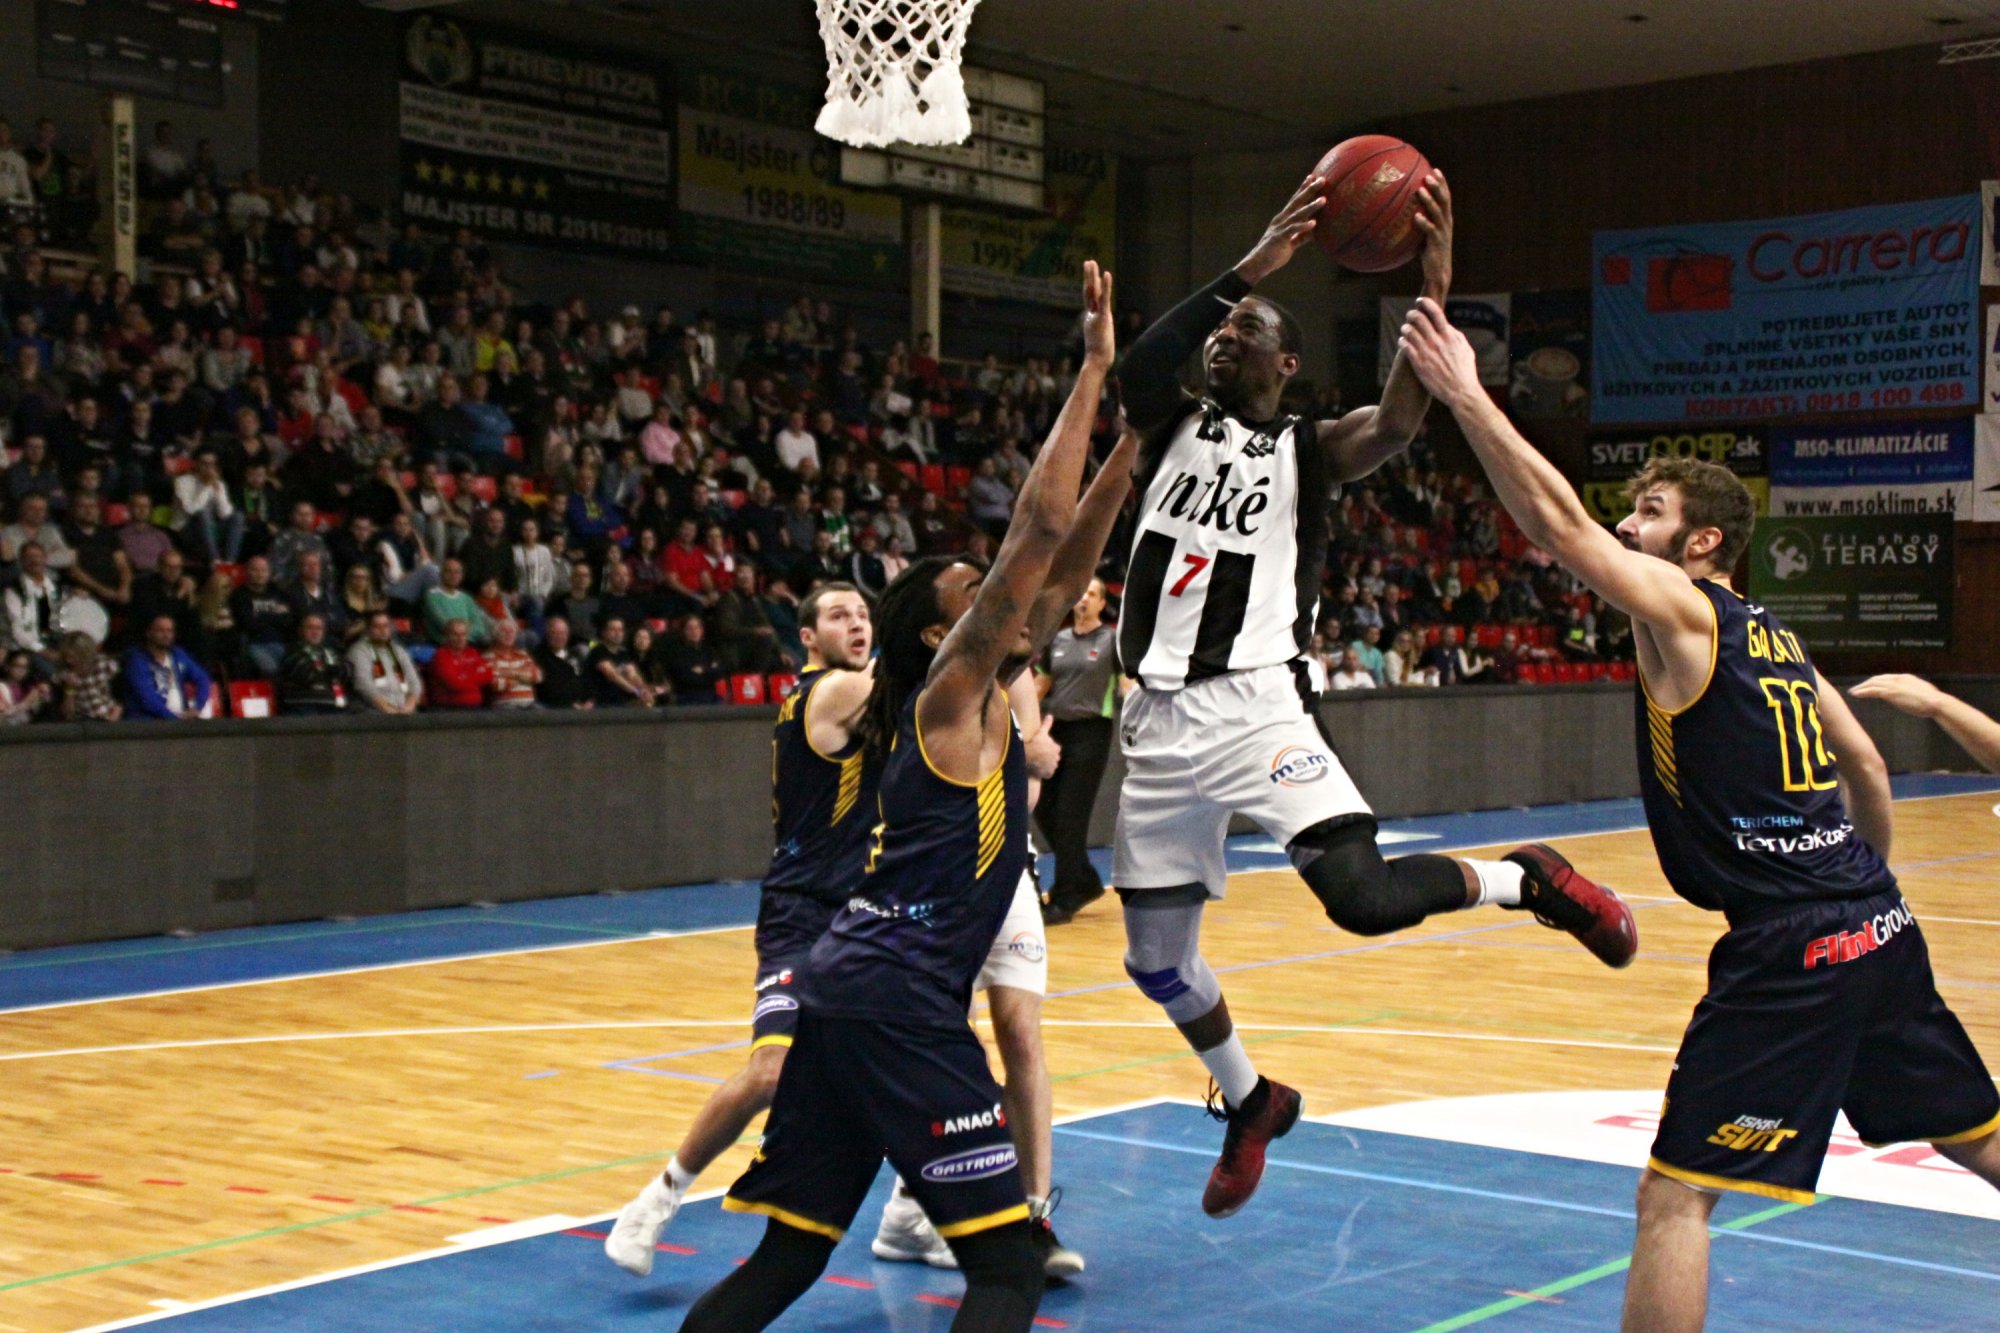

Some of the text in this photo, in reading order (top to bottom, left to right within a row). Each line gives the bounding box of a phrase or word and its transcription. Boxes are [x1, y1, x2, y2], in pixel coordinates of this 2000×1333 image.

[483, 45, 657, 102] PRIEVIDZA
[696, 124, 800, 173] Majster
[403, 191, 516, 230] MAJSTER
[524, 210, 554, 235] SR
[743, 185, 844, 229] 1988/89
[1746, 220, 1970, 283] Carrera
[1762, 302, 1970, 335] POTREBUJETE AUTO?
[1928, 321, 1970, 339] SNY
[1653, 361, 1721, 376] PREDAJ
[1728, 362, 1739, 375] A
[1720, 380, 1732, 394] A
[1878, 362, 1971, 385] VOZIDIEL
[1919, 382, 1964, 403] 498
[1794, 431, 1950, 458] MSO-KLIMATIZÁCIE
[1157, 462, 1270, 537] niké
[1785, 489, 1956, 515] www.msoklima.sk
[1822, 544, 1940, 566] TERASY
[1823, 532, 1940, 547] Fit shop
[1168, 553, 1211, 598] 7
[1269, 753, 1329, 784] msm
[1731, 815, 1804, 829] TERICHEM
[1706, 1123, 1799, 1152] SVIT
